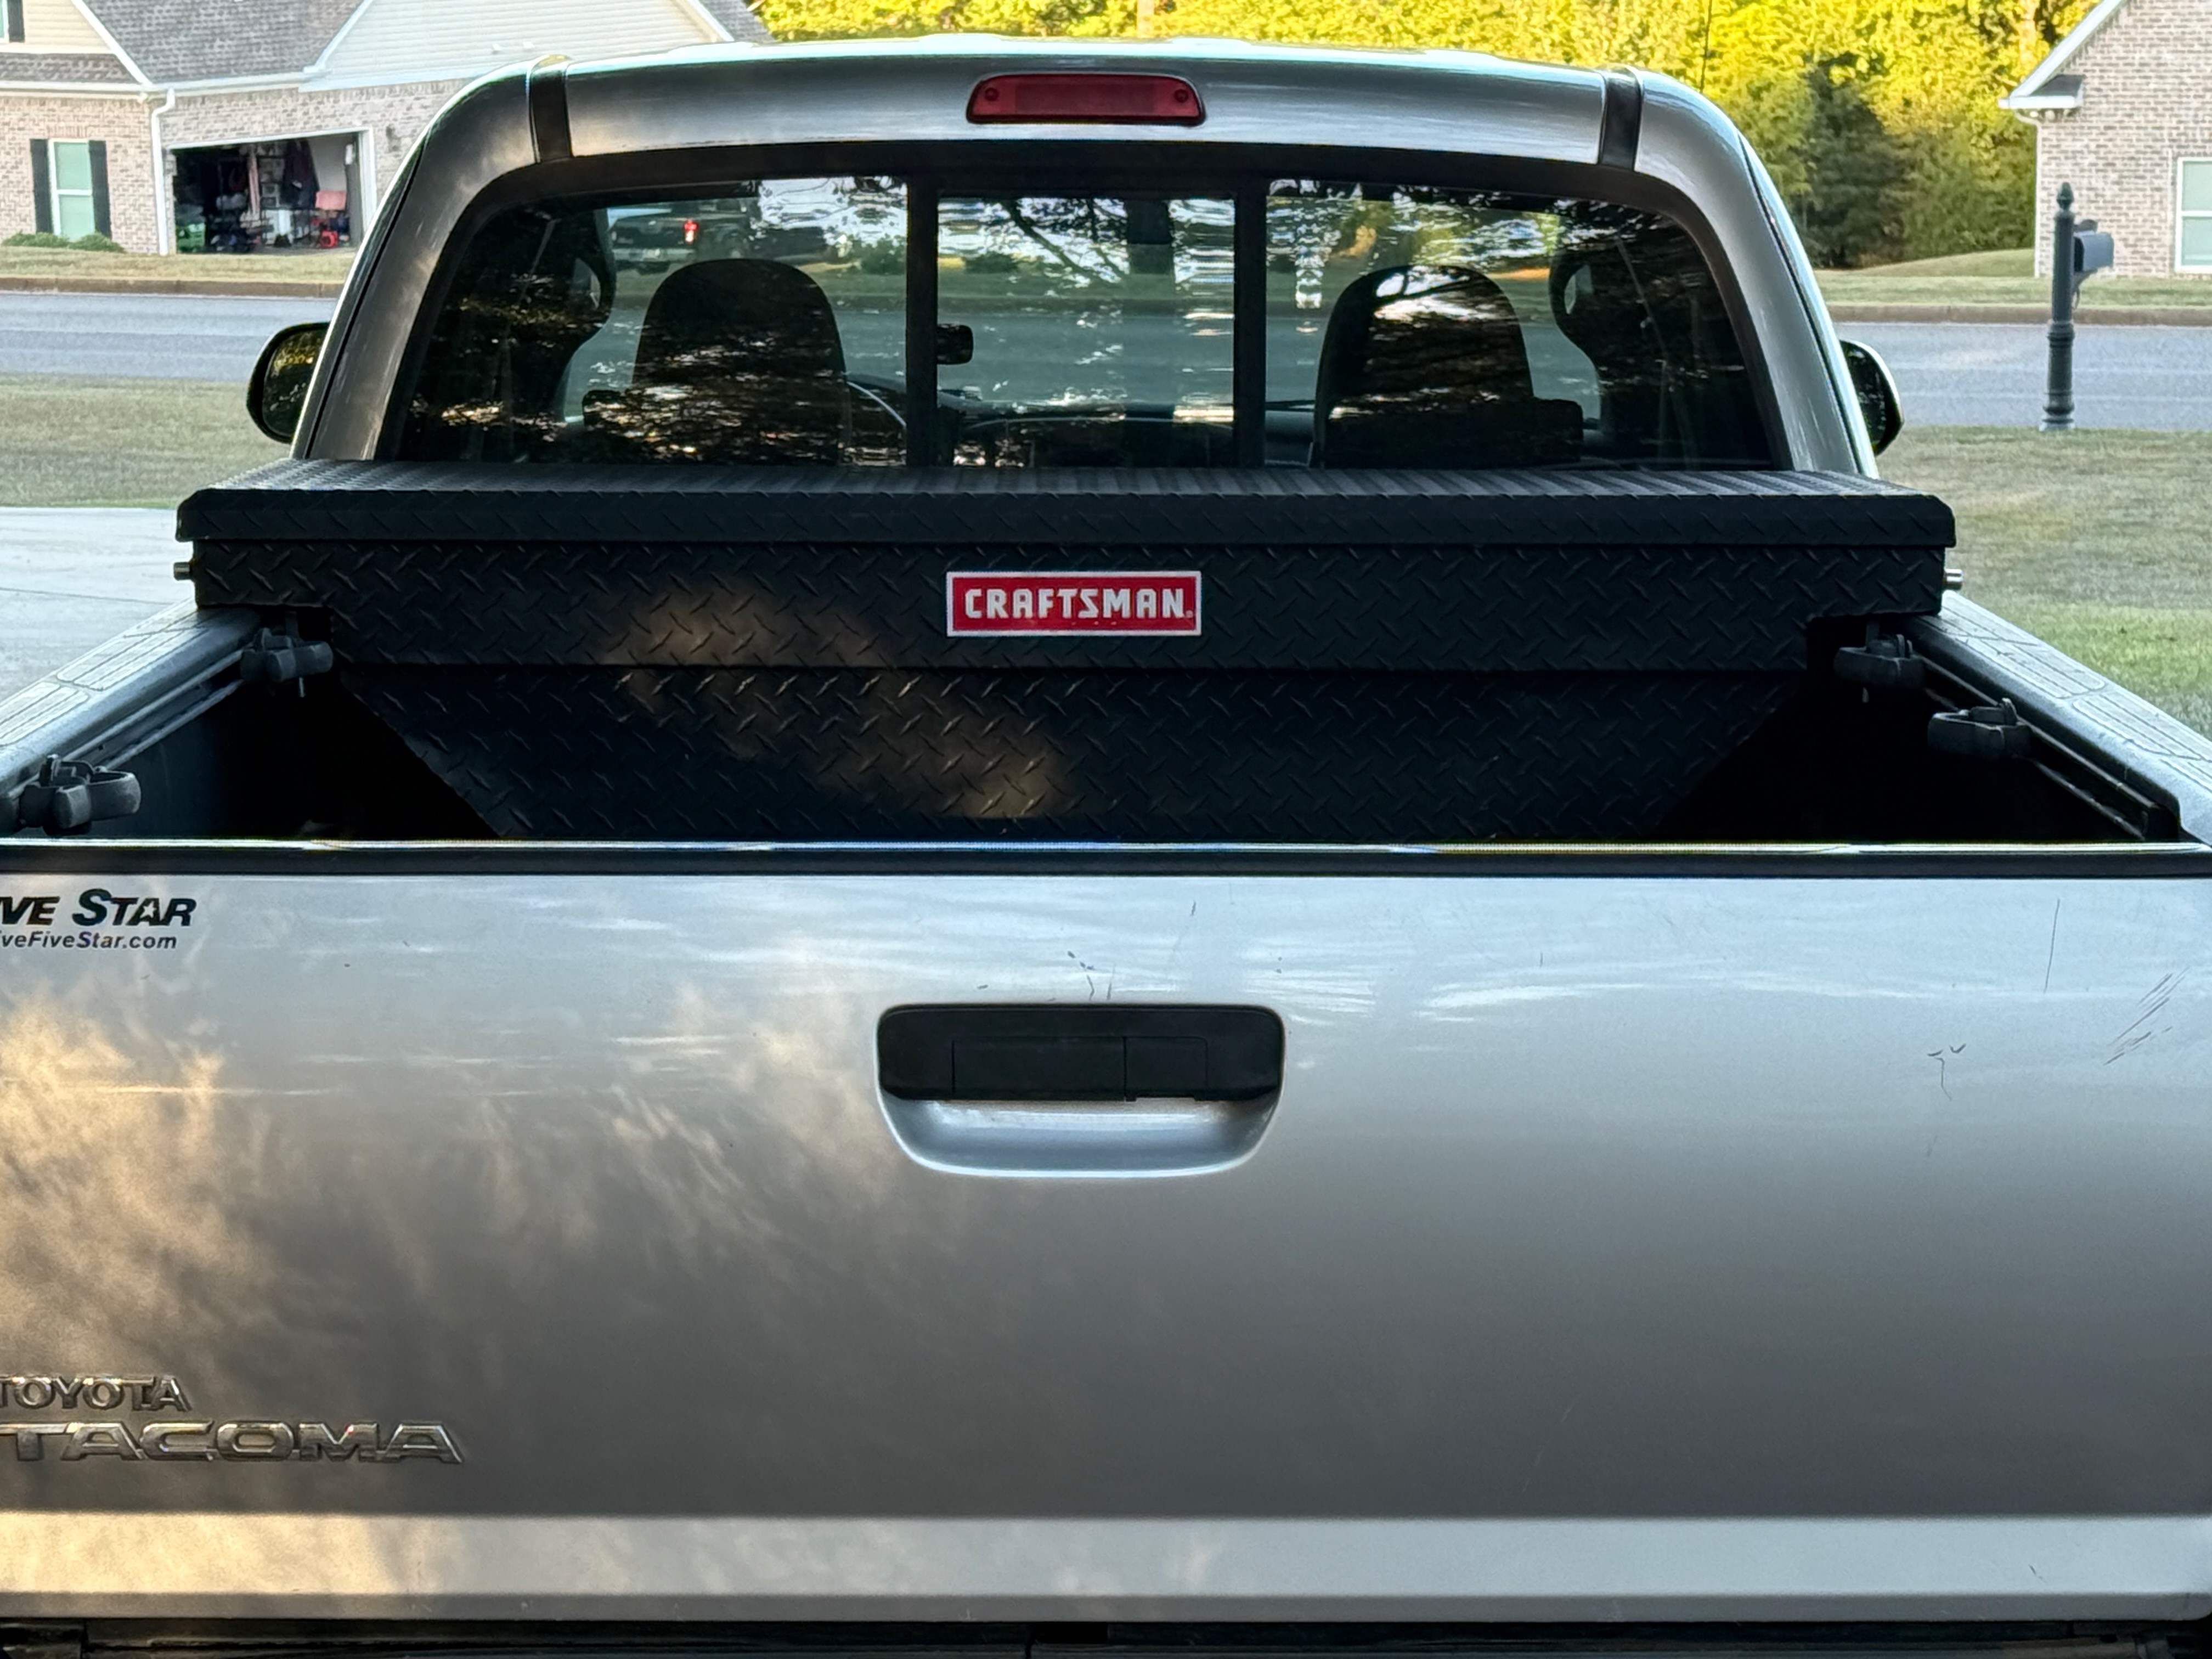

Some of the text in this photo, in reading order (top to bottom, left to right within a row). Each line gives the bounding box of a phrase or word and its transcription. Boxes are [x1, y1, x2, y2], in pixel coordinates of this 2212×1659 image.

[965, 588, 1185, 619] CRAFTSMAN
[0, 888, 196, 926] VE STAR
[0, 930, 177, 949] veFiveStar.com
[0, 1421, 463, 1463] TACOMA
